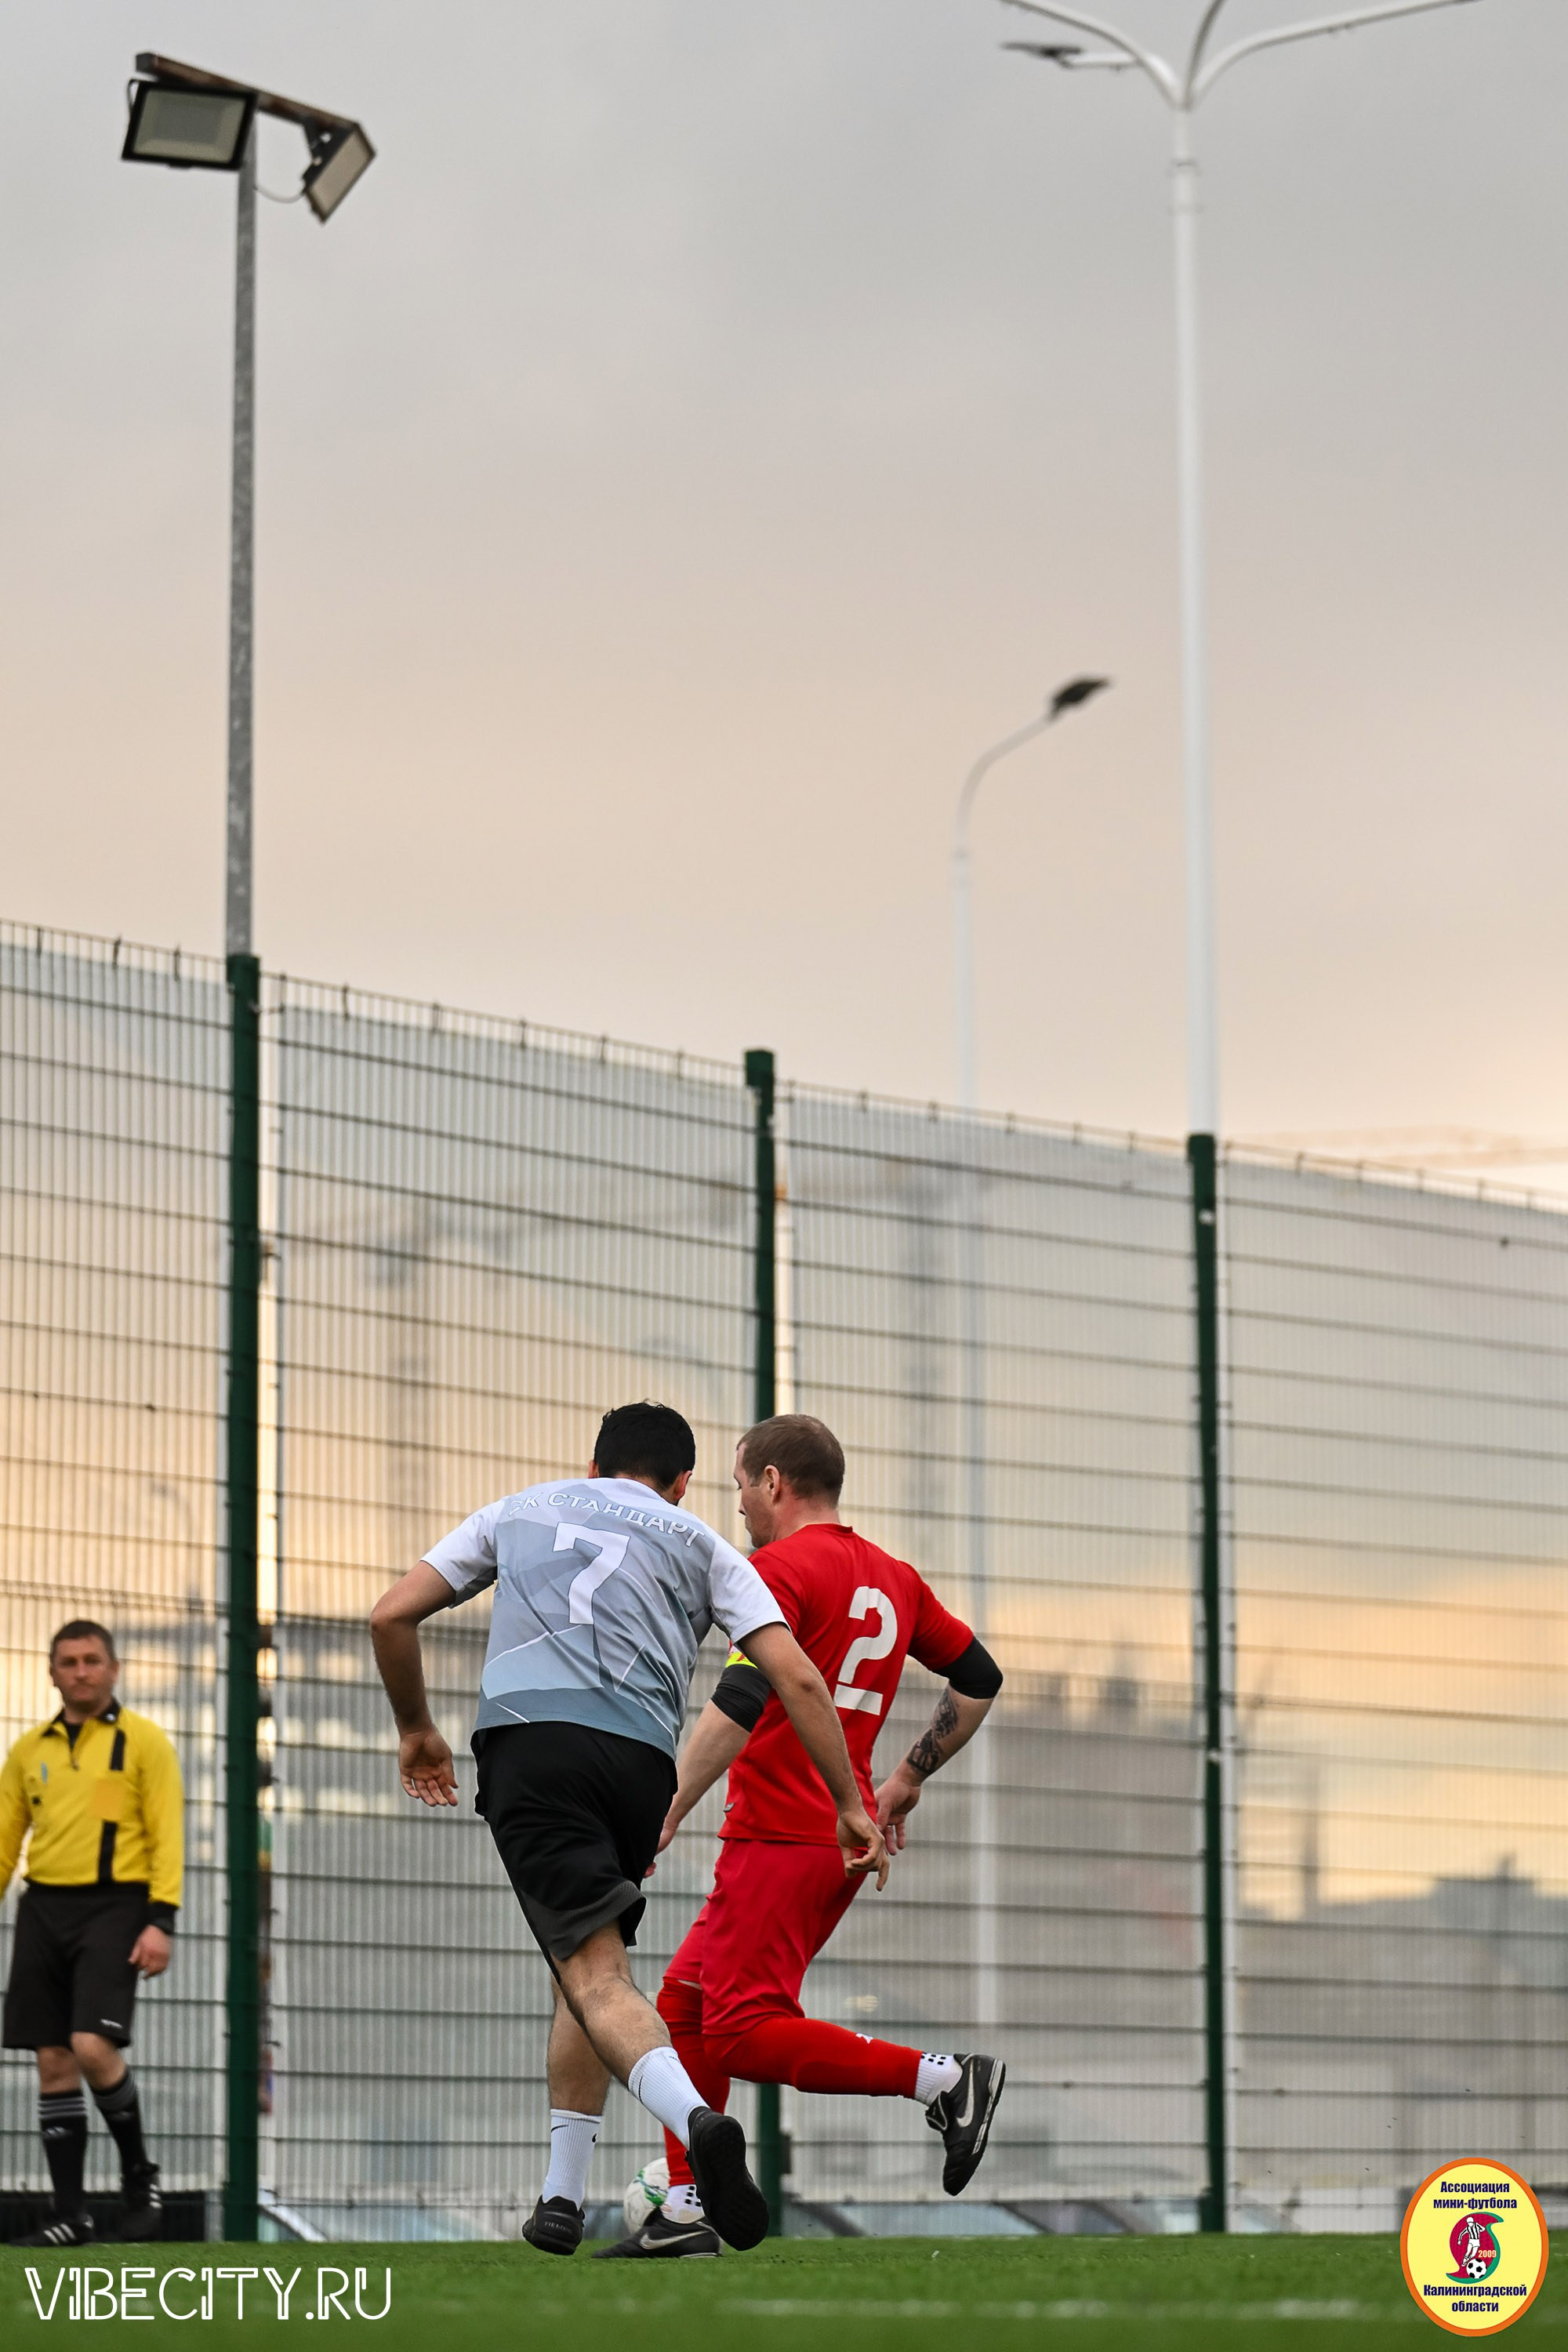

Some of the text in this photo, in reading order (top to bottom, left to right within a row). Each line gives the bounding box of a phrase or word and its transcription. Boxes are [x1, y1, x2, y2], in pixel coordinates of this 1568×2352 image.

[547, 1492, 705, 1548] СТАНДАРТ
[552, 1521, 631, 1625] 7
[833, 1585, 898, 1716] 2
